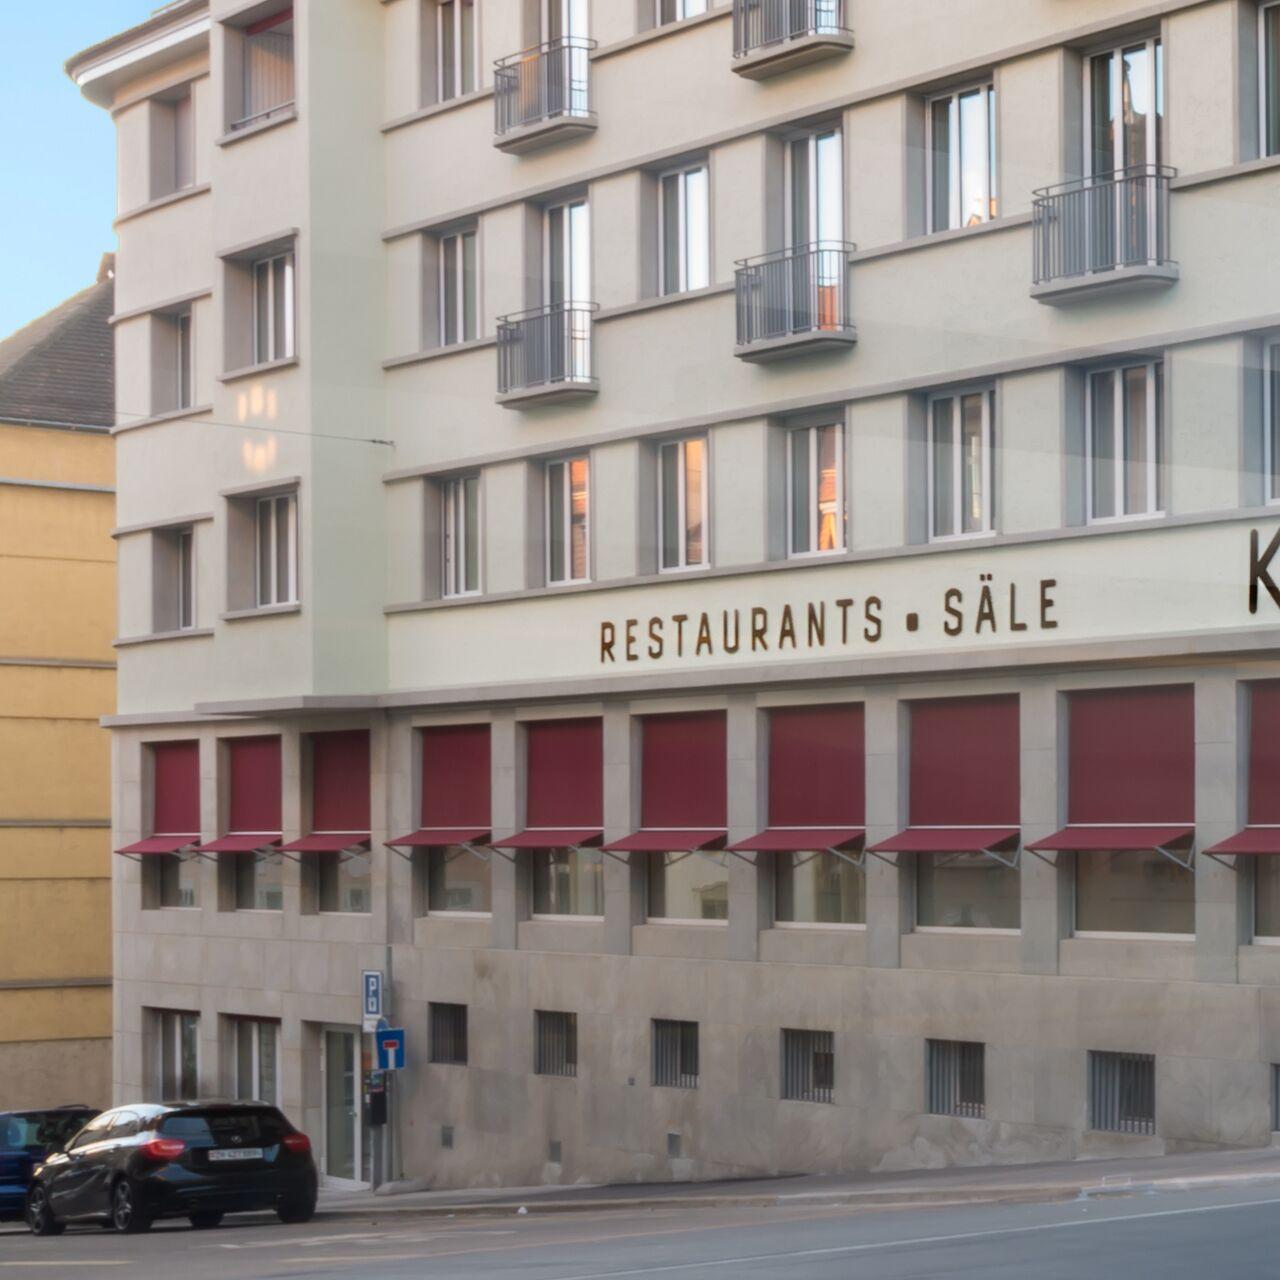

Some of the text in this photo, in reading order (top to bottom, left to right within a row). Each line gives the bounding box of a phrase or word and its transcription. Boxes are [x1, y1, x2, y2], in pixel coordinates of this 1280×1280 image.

[600, 573, 1059, 663] RESTAURANTS SÄLE
[368, 977, 378, 996] P
